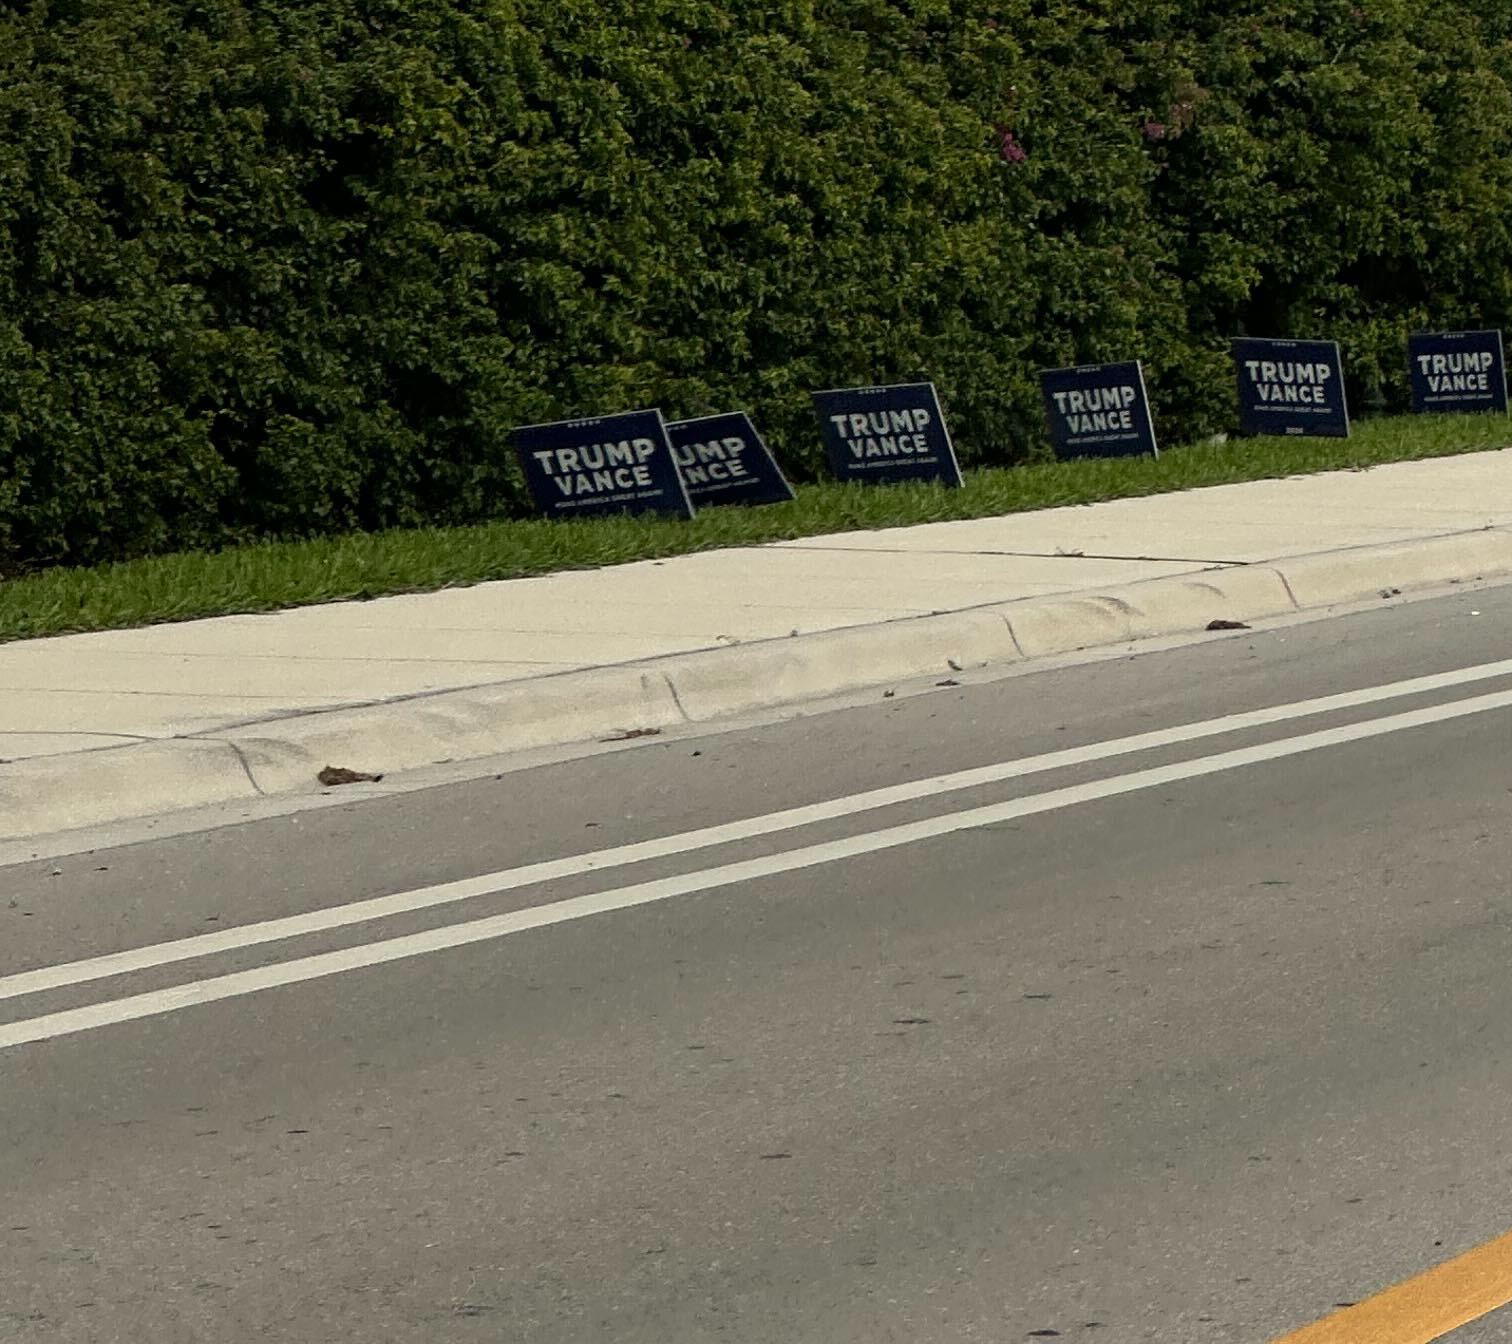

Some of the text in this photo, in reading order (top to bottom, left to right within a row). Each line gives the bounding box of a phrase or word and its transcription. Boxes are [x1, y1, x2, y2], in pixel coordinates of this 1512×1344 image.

[1245, 360, 1331, 384] TRUMP
[1417, 352, 1493, 376] TRUMP
[1256, 382, 1325, 404] VANCE
[1427, 373, 1489, 393] VANCE
[1052, 385, 1136, 414] TRUMP
[830, 408, 931, 439] TRUMP
[1065, 410, 1133, 434] VANCE
[532, 437, 656, 475] TRUMP
[675, 436, 747, 467] UMP
[847, 433, 929, 458] VANCE
[553, 465, 653, 496] VANCE
[682, 458, 749, 485] NCE
